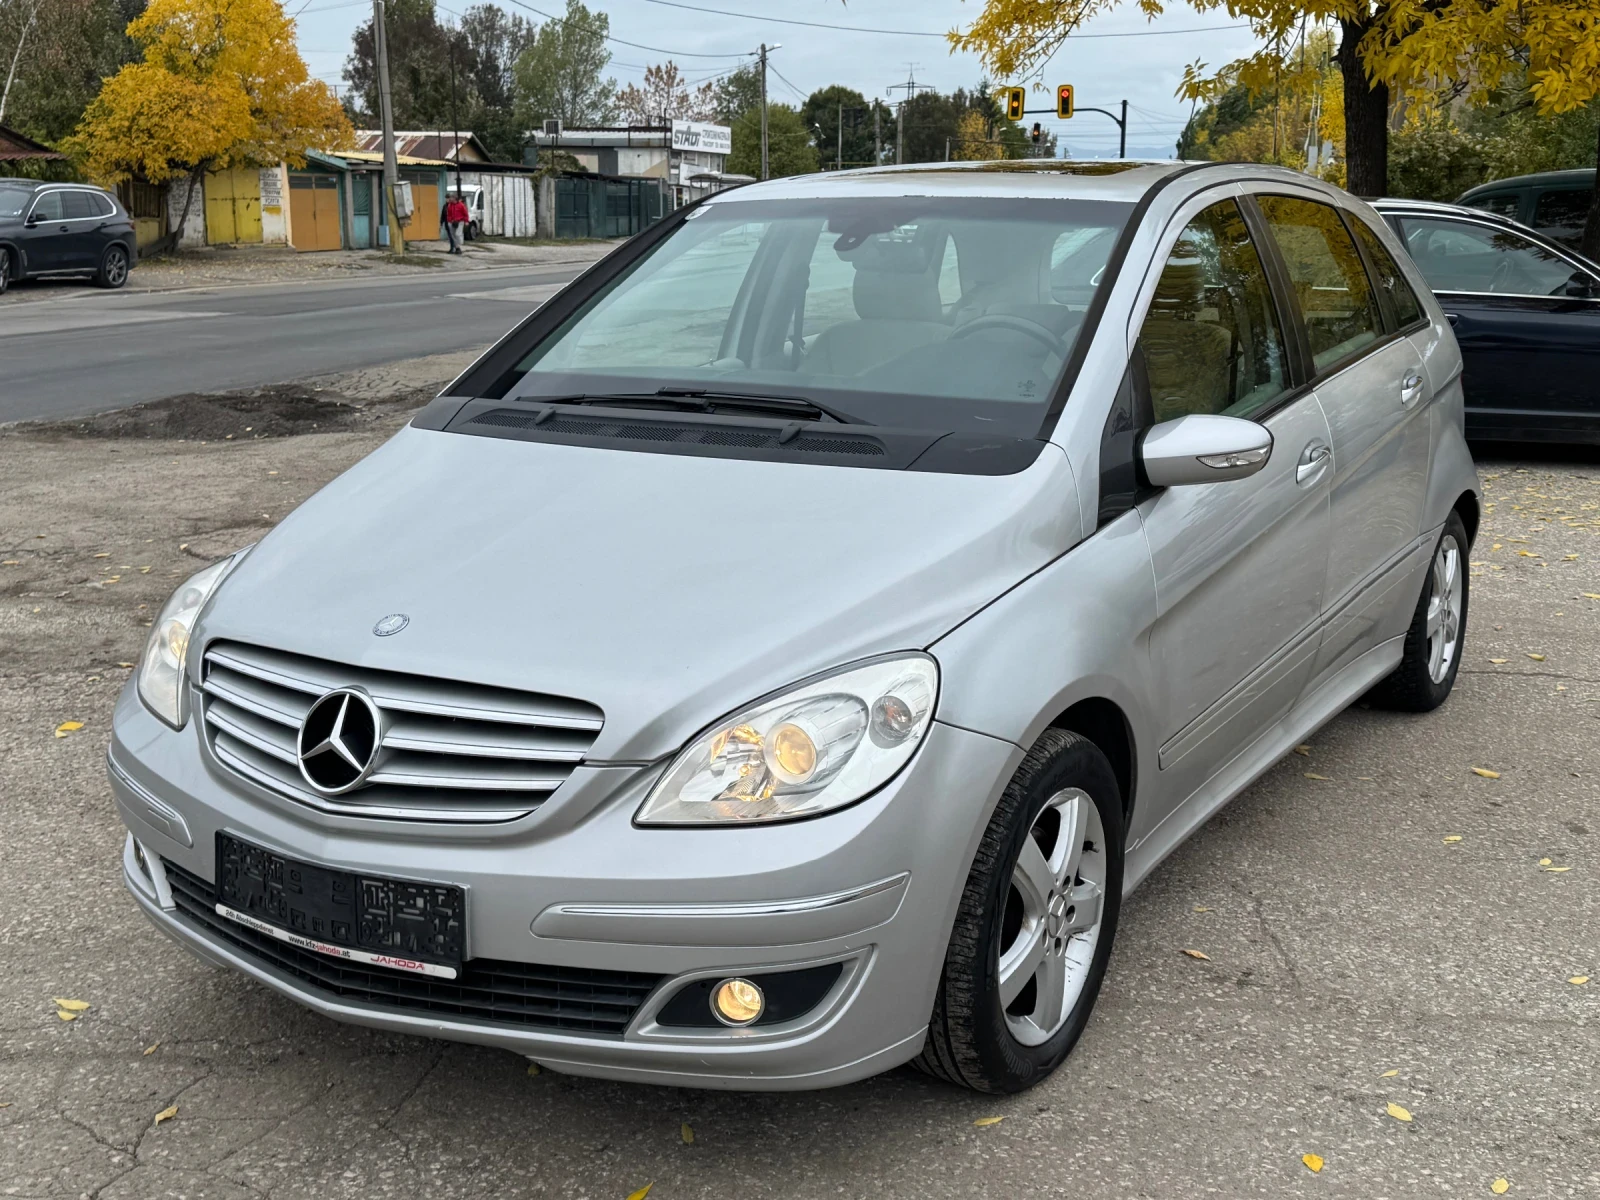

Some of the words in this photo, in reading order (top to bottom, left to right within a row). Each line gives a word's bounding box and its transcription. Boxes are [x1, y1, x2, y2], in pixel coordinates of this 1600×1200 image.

[225, 909, 236, 918] 24h
[288, 936, 350, 957] www.kfz-jahoda.at
[370, 955, 425, 970] JAHODA
